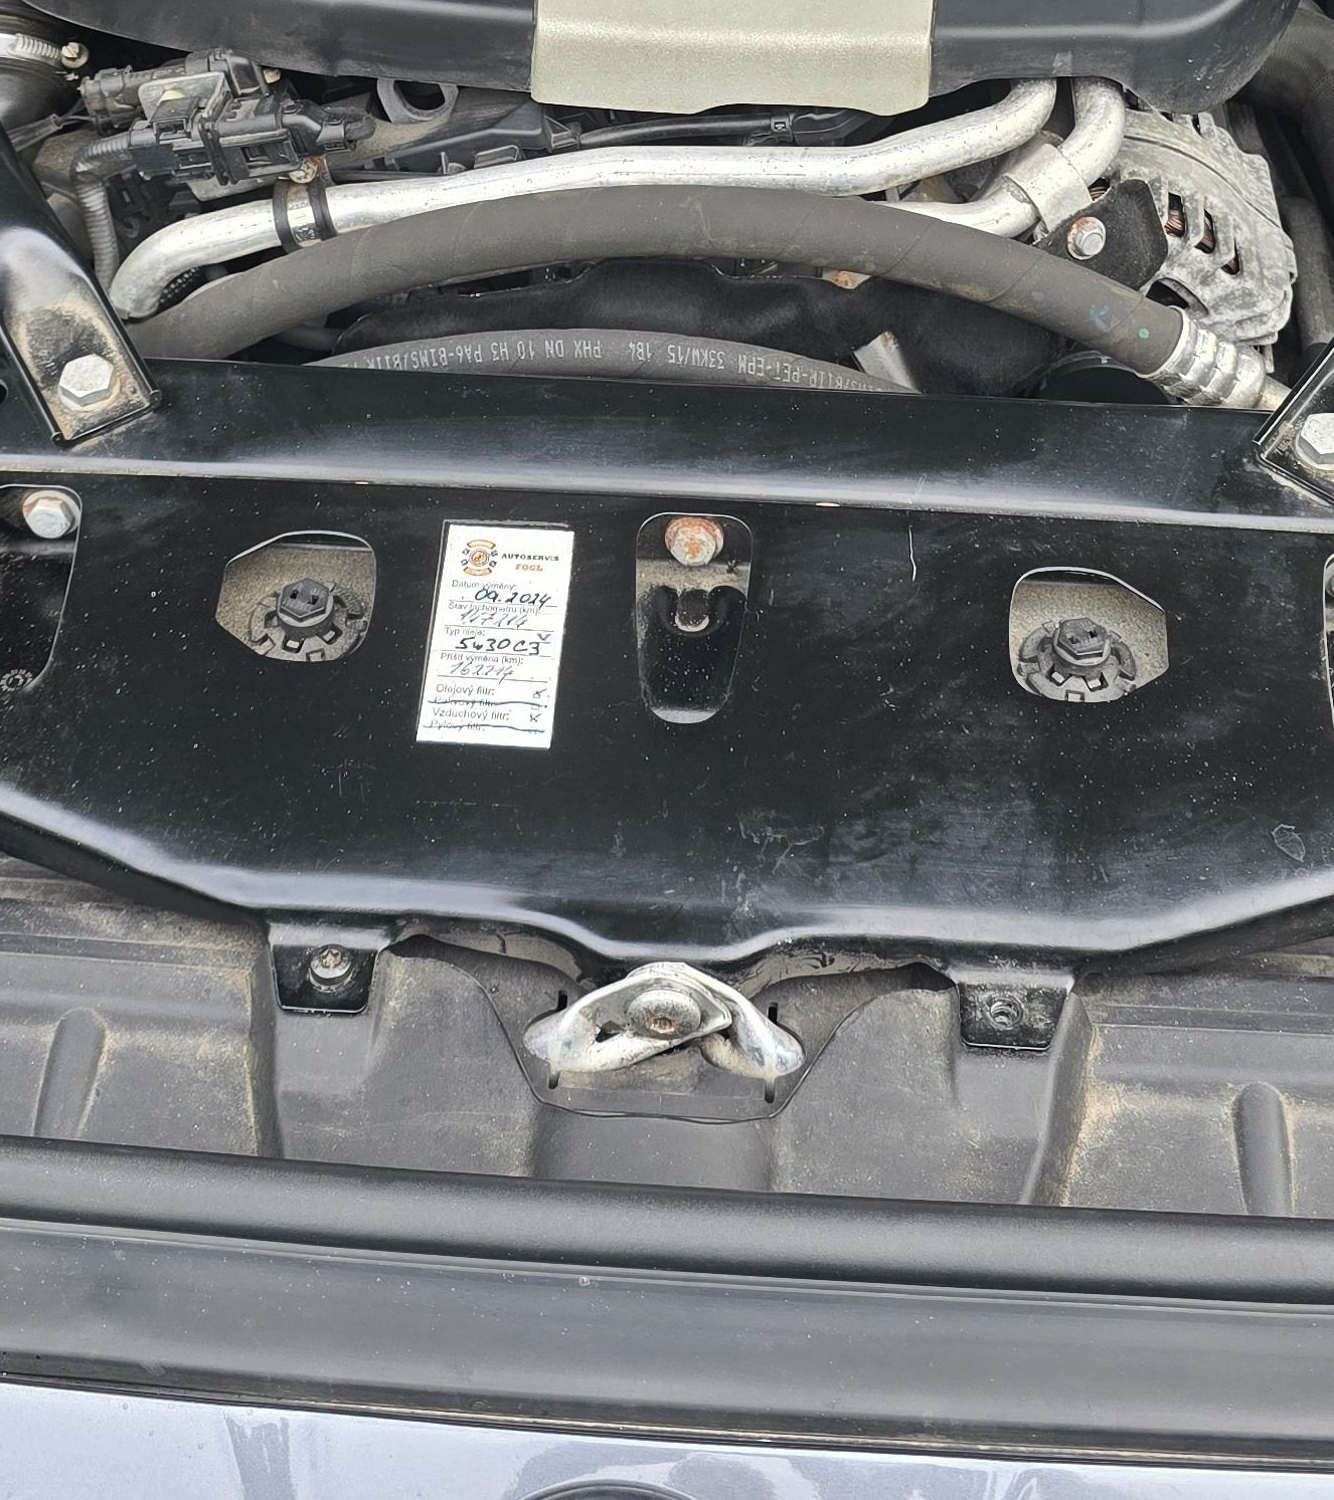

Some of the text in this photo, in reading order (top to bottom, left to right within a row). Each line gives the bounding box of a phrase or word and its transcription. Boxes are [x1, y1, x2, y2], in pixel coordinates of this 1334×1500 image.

[491, 341, 508, 361] H3
[517, 340, 534, 360] 10
[544, 339, 565, 358] DN
[573, 339, 603, 358] PHX
[501, 553, 560, 562] AUTOSERVIS
[451, 579, 480, 589] Datum
[448, 601, 467, 610] Stav
[444, 626, 461, 636] Typ
[432, 706, 488, 721] Vzduchový
